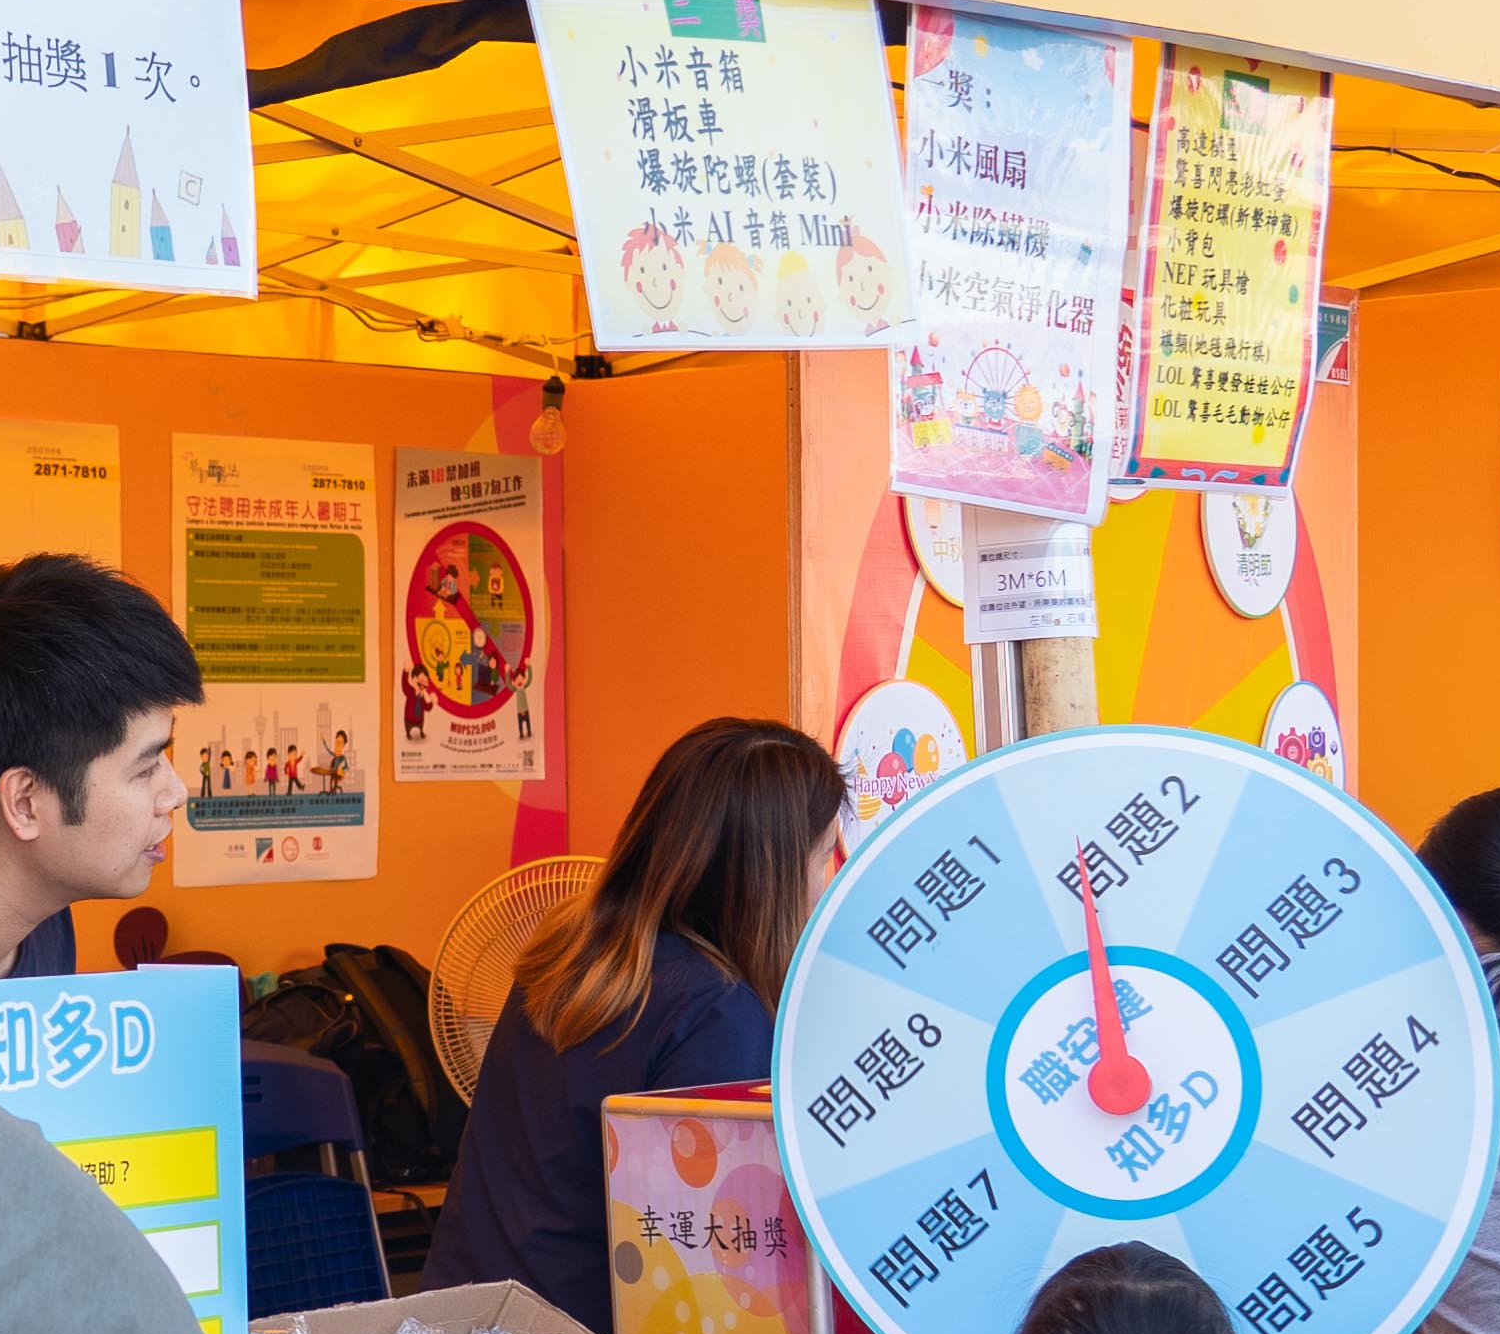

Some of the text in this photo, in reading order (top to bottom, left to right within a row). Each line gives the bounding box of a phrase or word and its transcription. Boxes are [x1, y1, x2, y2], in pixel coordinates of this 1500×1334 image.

[100, 53, 120, 92] 1
[618, 44, 745, 94] 小米音箱
[627, 96, 724, 146] 滑板車
[636, 147, 837, 205] 爆旋陀螺(套裝)
[919, 128, 1027, 190] 小米風扇
[643, 205, 854, 252] 小米 AI 音箱 Mini
[1165, 227, 1215, 259] 小背包
[1162, 260, 1251, 295] NEF 玩具槍
[1156, 364, 1185, 386] LOL
[1153, 398, 1182, 418] LOL
[34, 462, 107, 480] 2871-7810
[312, 477, 366, 491] 2871-7810
[852, 774, 895, 798] Happy
[1105, 1067, 1220, 1184] 知多D
[636, 1204, 789, 1260] 幸運大抽獎
